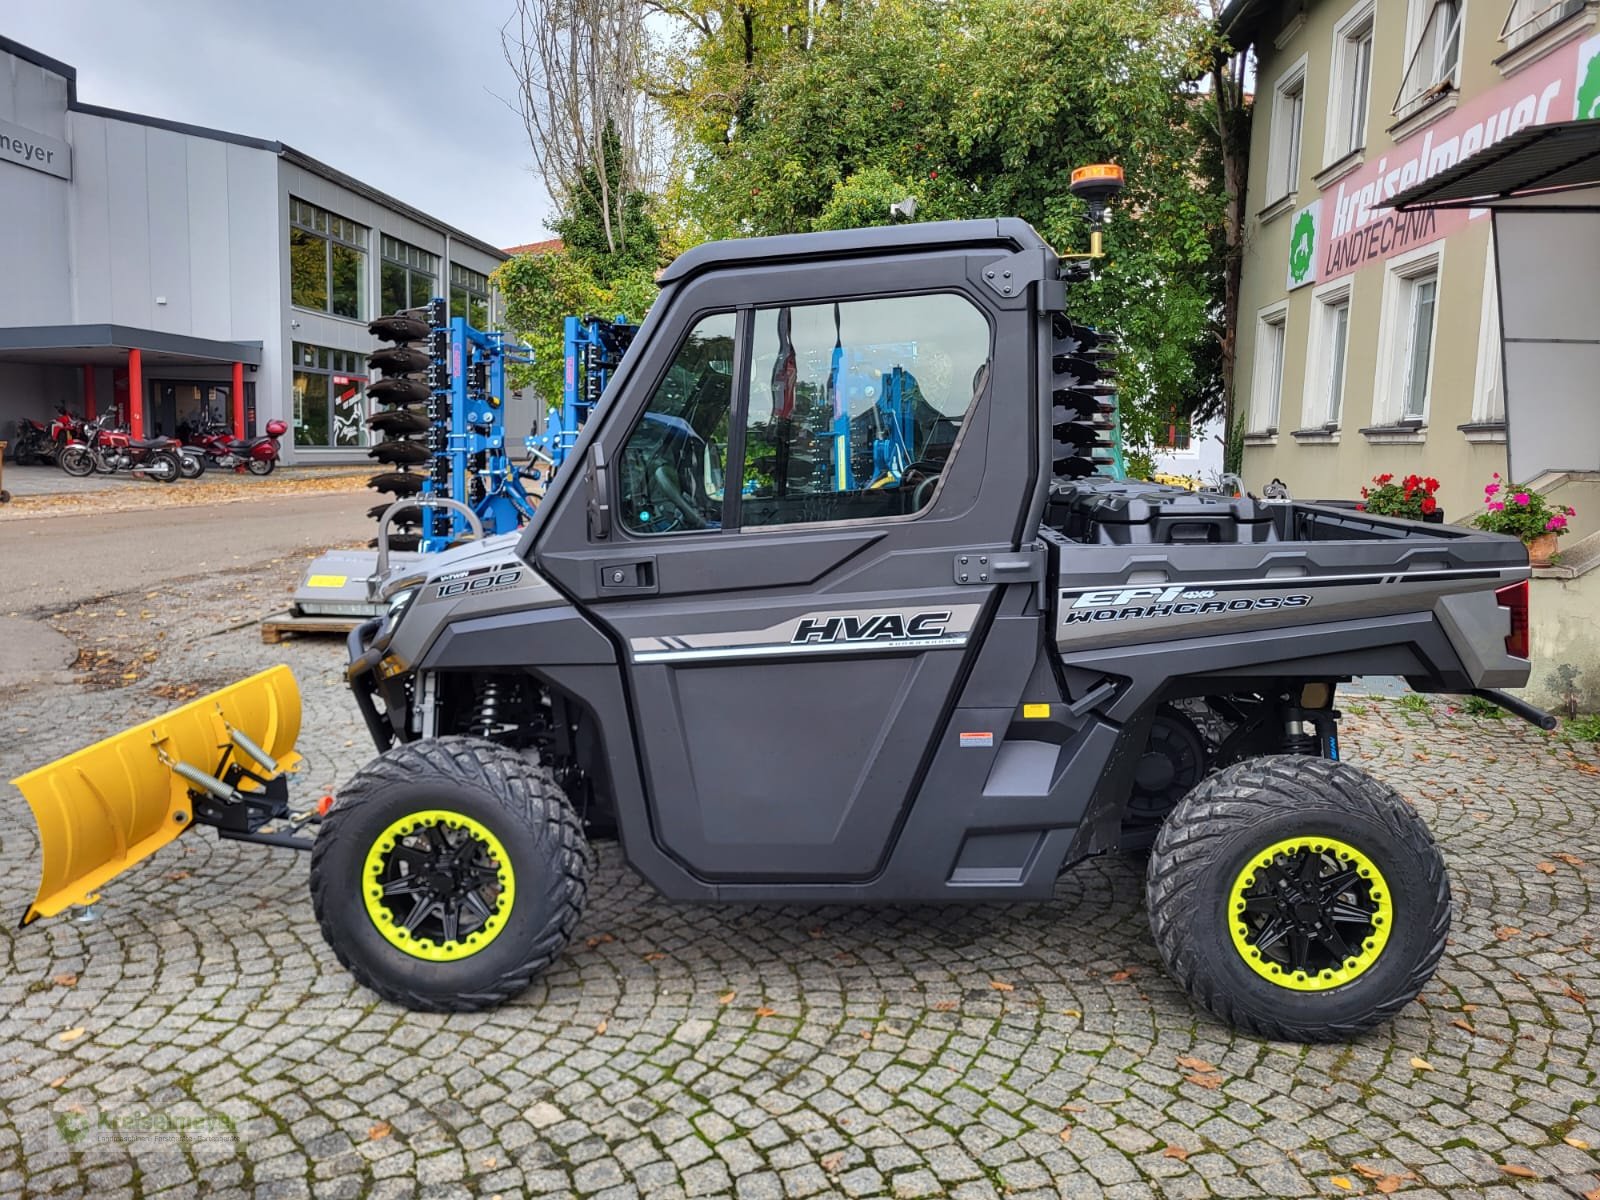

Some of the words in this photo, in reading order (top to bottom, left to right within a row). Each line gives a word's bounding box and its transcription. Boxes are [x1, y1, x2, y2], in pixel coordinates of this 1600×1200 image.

[1325, 202, 1437, 276] LANDTECHNIK
[436, 569, 523, 598] 1000
[1071, 587, 1187, 610] EFI
[1063, 594, 1313, 625] WORKCROSS
[790, 611, 952, 644] HVAC
